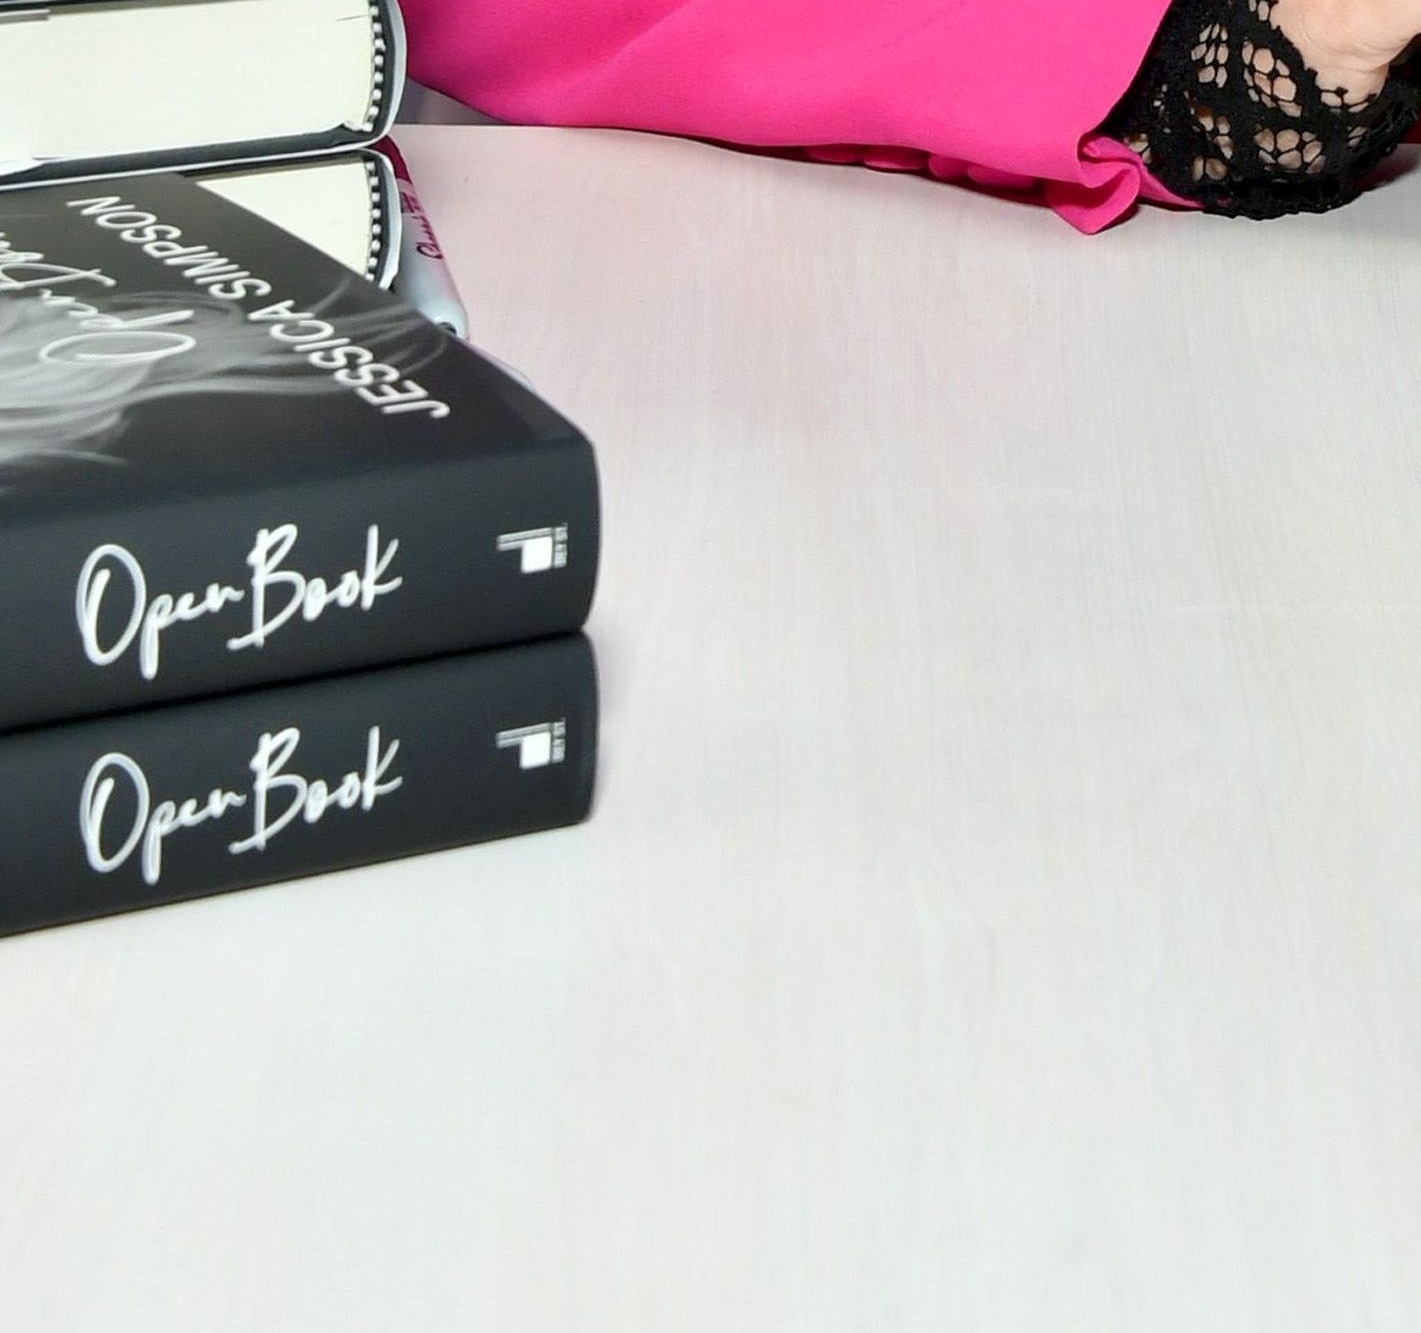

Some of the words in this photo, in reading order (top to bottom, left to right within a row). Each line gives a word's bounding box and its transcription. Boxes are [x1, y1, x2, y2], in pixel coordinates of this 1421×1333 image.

[66, 195, 273, 300] SIMPSON
[247, 299, 452, 419] JESSICA
[76, 542, 246, 681] Open
[228, 523, 403, 652] Book
[79, 751, 247, 886] Open
[229, 727, 403, 854] Book
